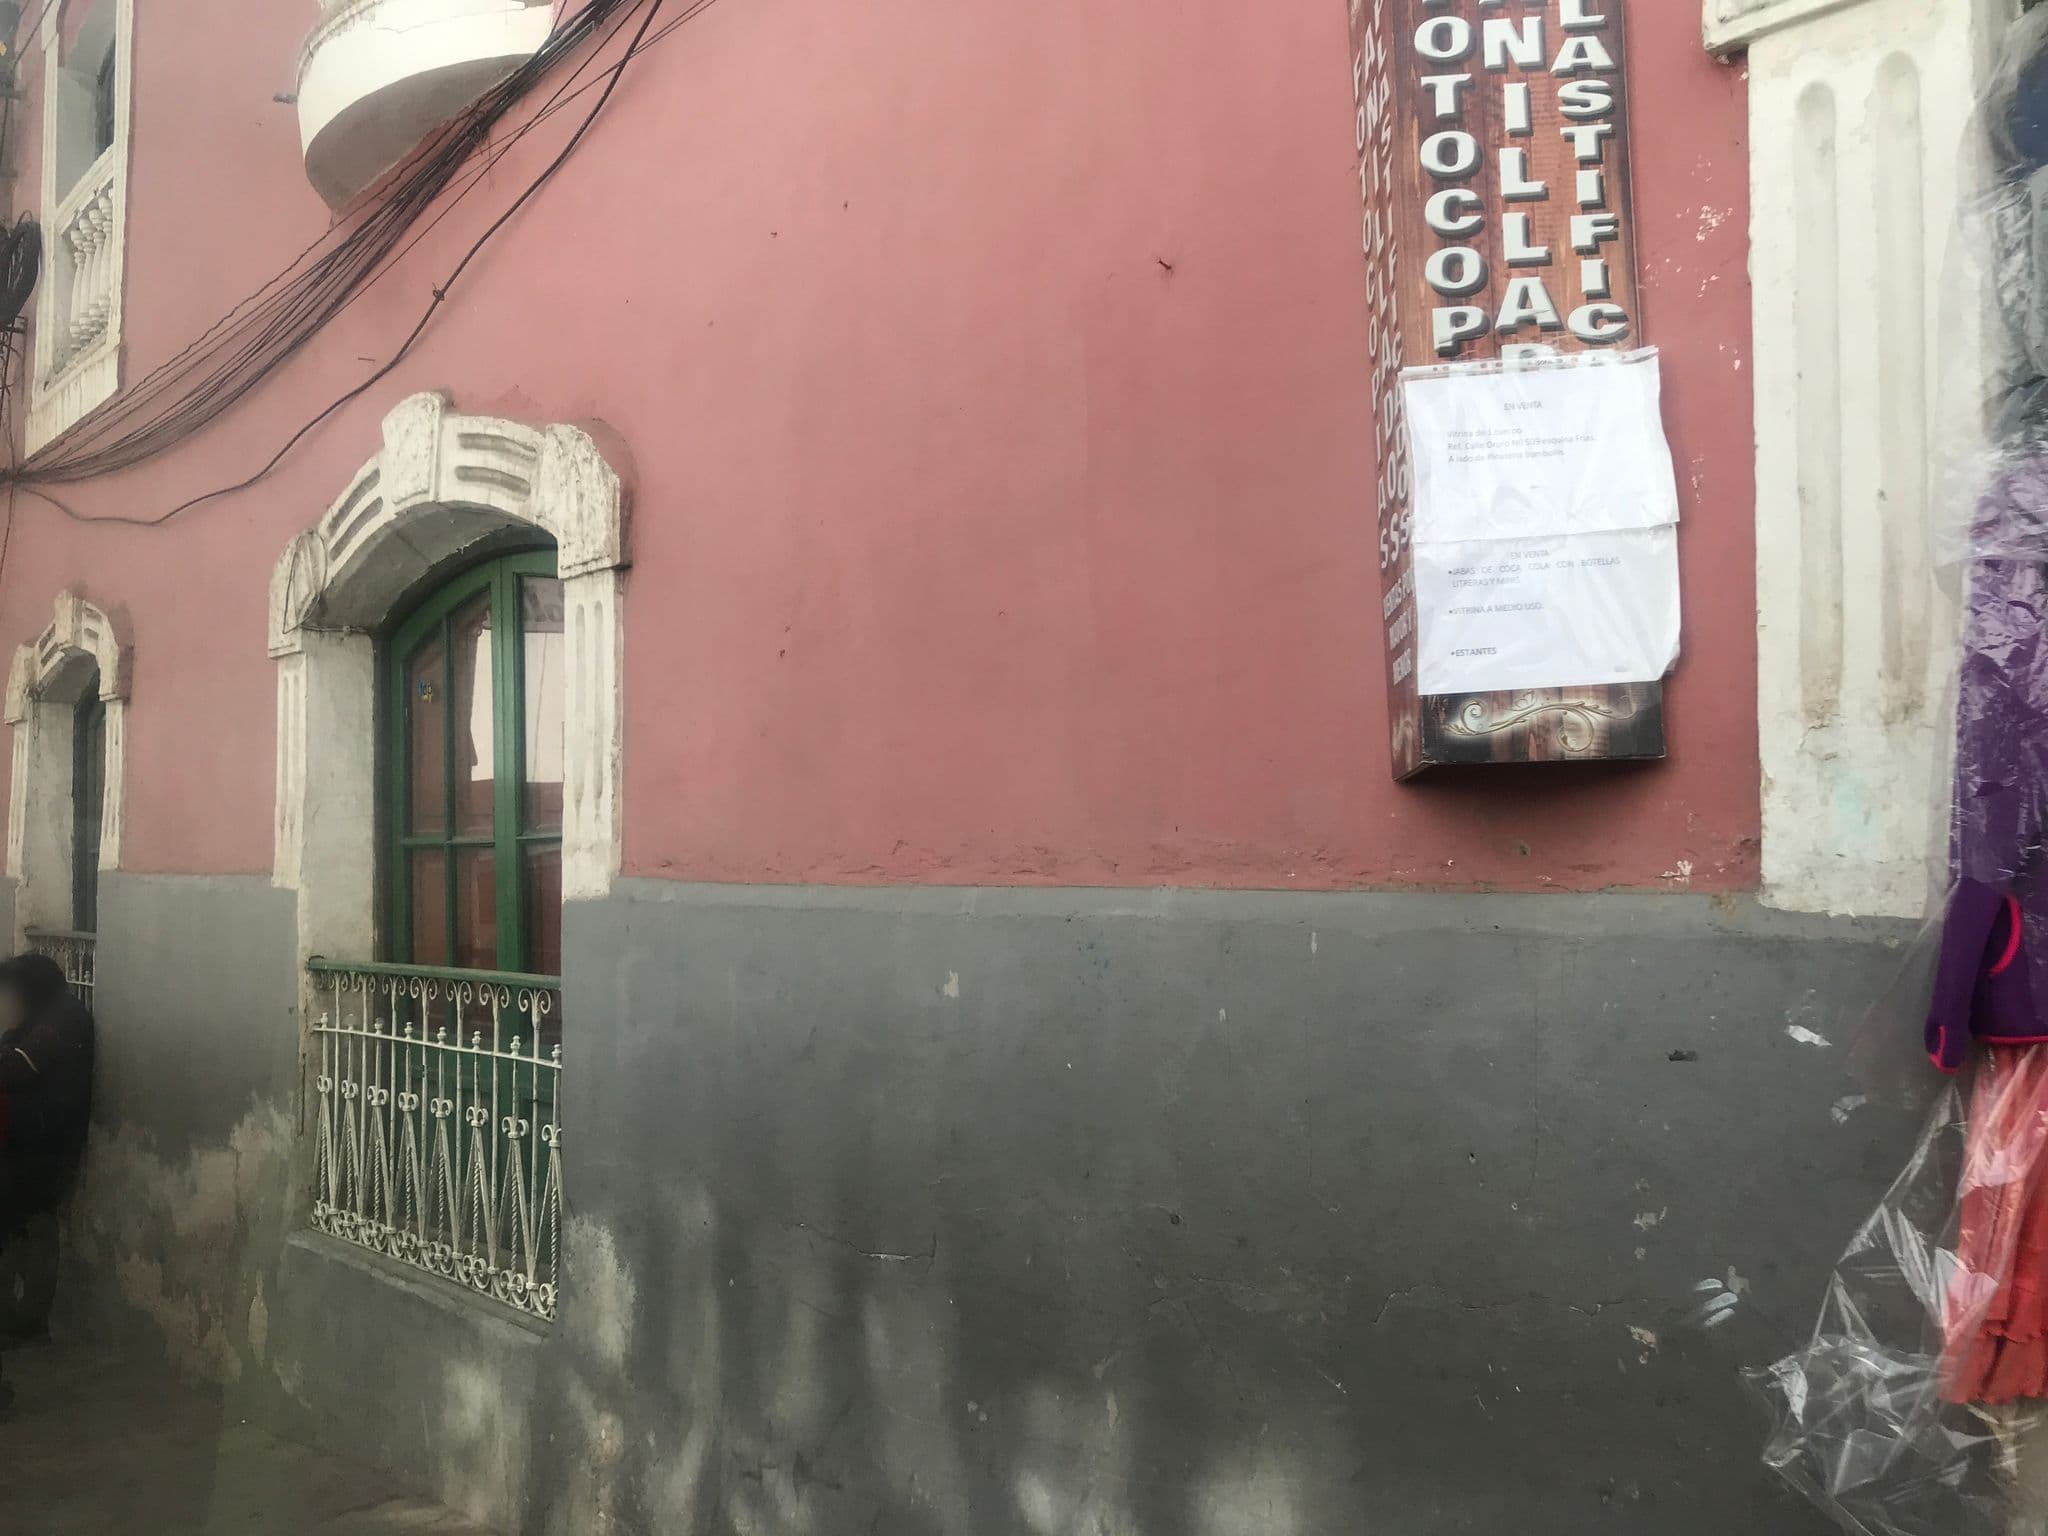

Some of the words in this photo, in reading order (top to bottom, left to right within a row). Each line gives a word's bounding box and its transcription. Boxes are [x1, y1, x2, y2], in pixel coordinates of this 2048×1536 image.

[1414, 0, 1490, 353] OTOCOP
[1353, 49, 1389, 570] FOTOCOPIAS
[1518, 401, 1543, 410] VENTA
[1510, 551, 1522, 560] EN
[1524, 549, 1551, 559] VENTA
[1481, 565, 1493, 574] DE
[1499, 563, 1522, 573] COCA
[1528, 561, 1551, 571] COLA
[1555, 560, 1575, 570] CON
[1580, 556, 1622, 567] BOTELLAS
[1495, 603, 1523, 613] MEDIO
[1455, 646, 1498, 657] ESTANTES
